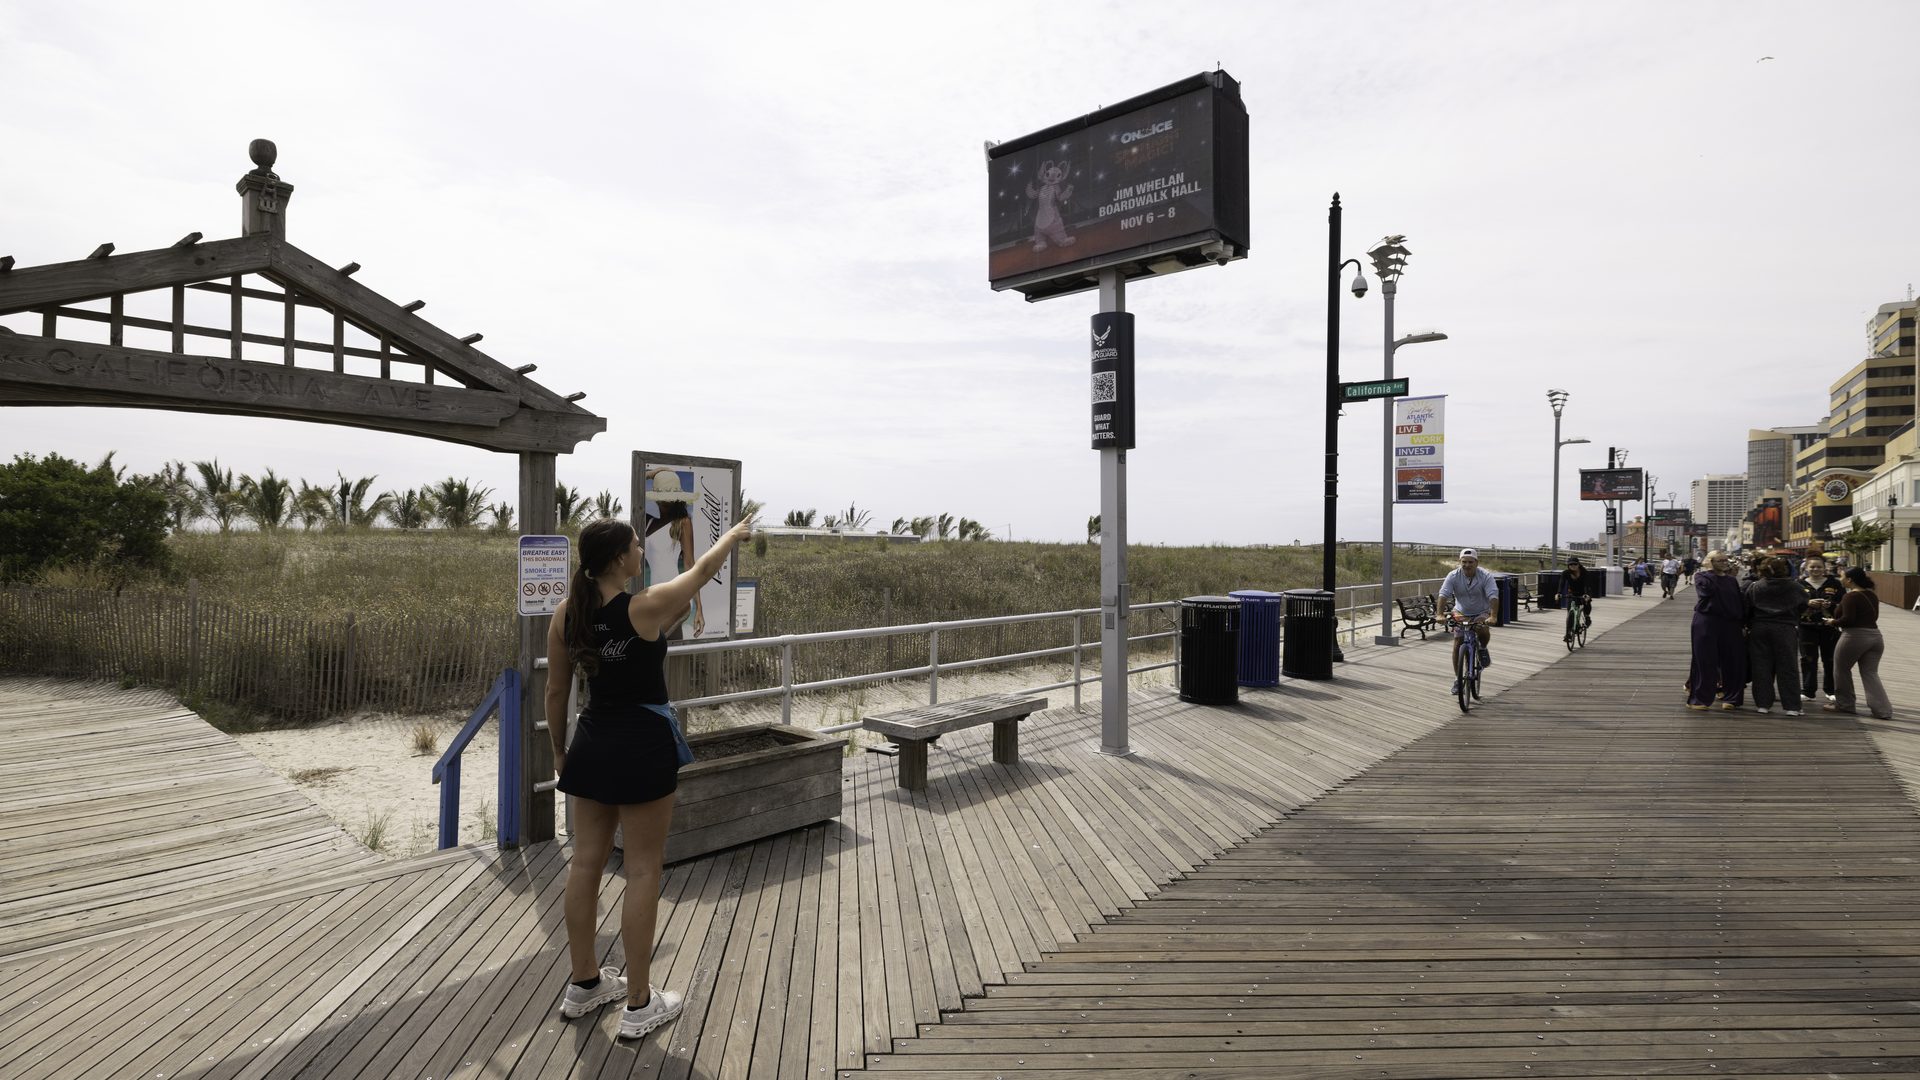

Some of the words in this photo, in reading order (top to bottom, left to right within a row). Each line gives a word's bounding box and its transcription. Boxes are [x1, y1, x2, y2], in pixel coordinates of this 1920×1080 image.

[1121, 129, 1142, 144] ON
[1152, 119, 1174, 135] ICE
[1113, 185, 1134, 202] JIM
[1135, 171, 1185, 196] WHELAN
[1099, 188, 1168, 217] BOARDWALK
[1171, 180, 1202, 198] HALL
[1120, 214, 1144, 231] NOV
[1146, 212, 1154, 224] 6
[1168, 206, 1176, 218] 8
[45, 347, 327, 400] CALIFORNIA
[360, 383, 433, 411] AVE
[1347, 384, 1391, 397] California
[1094, 413, 1112, 422] GUARD
[1406, 412, 1434, 420] ATLANTIC
[1095, 422, 1110, 431] WHAT
[1398, 425, 1418, 434] LIVE
[1398, 446, 1430, 456] INVEST
